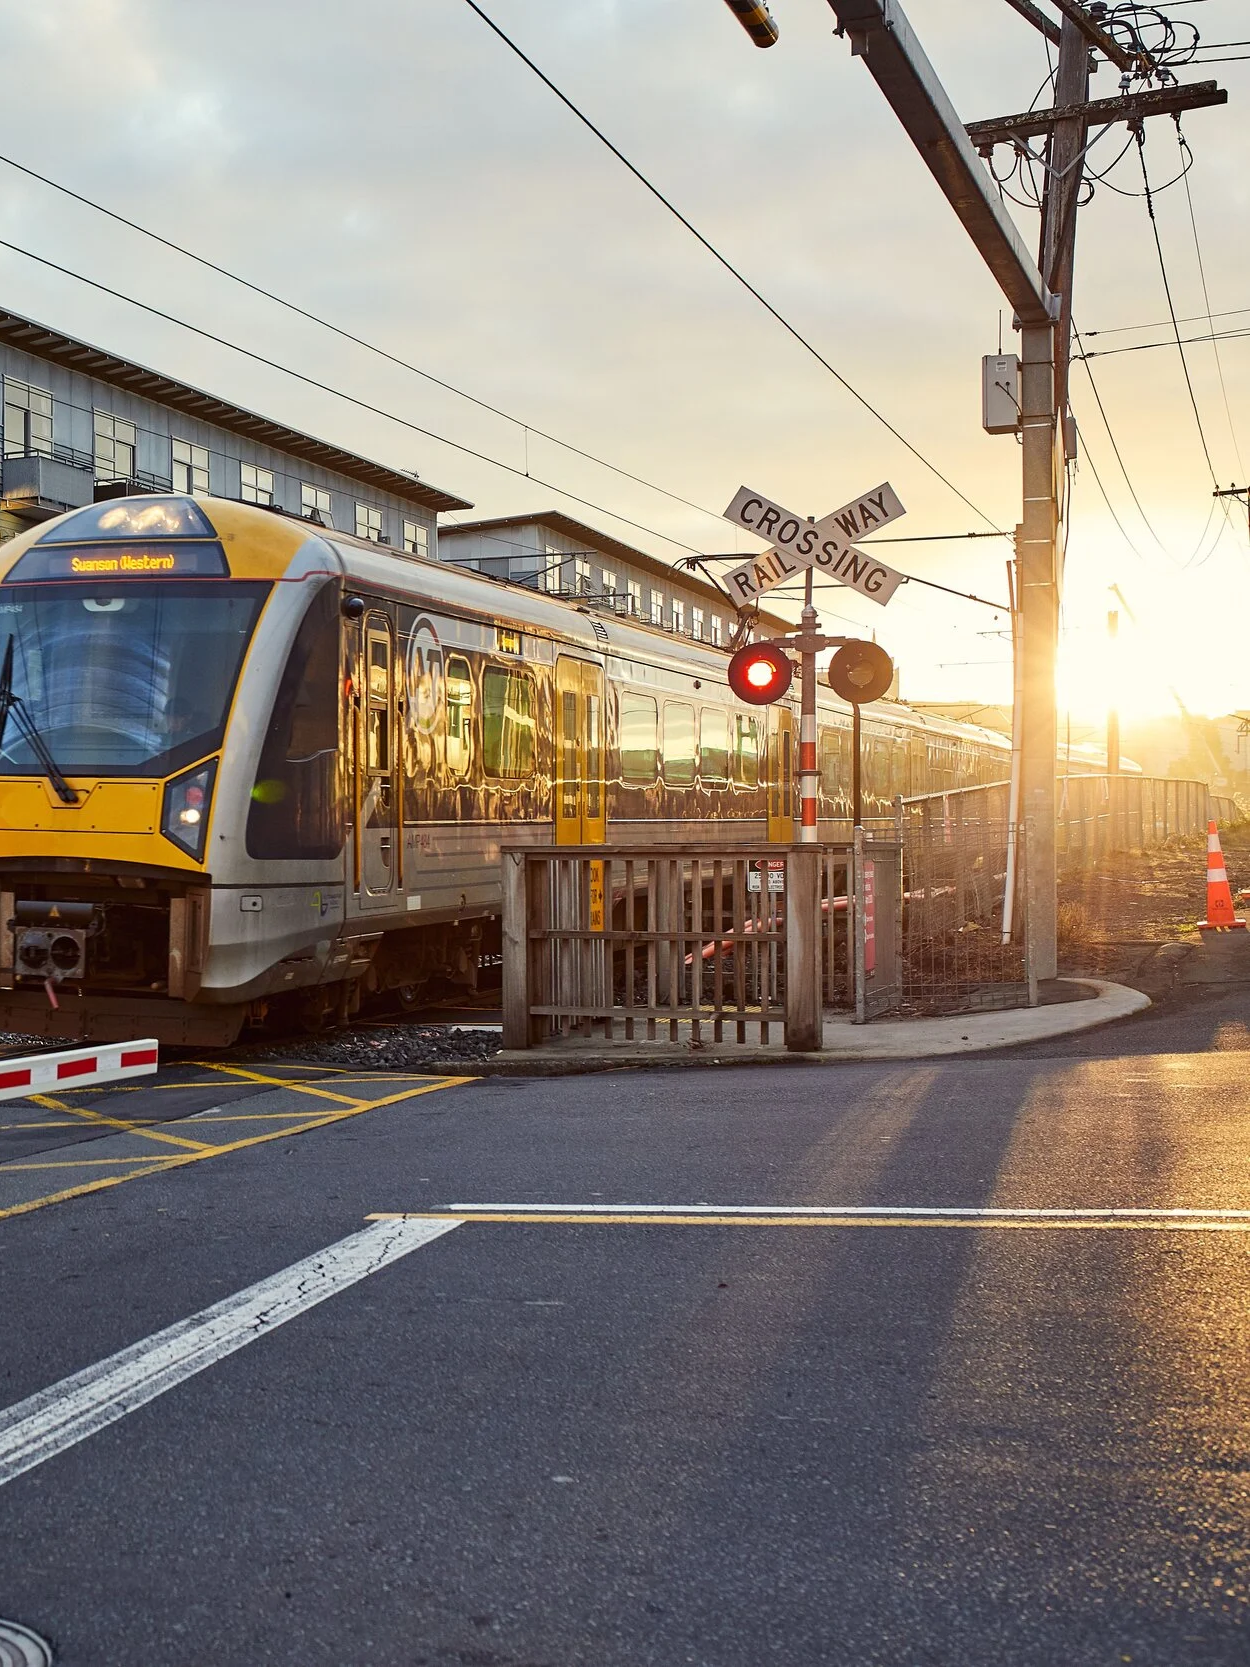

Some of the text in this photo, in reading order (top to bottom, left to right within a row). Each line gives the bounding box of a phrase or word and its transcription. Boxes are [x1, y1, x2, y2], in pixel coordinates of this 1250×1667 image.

[71, 554, 175, 572] Swanson (Western)
[733, 492, 889, 597] RAIL WAY
[740, 498, 887, 593] CROSSING
